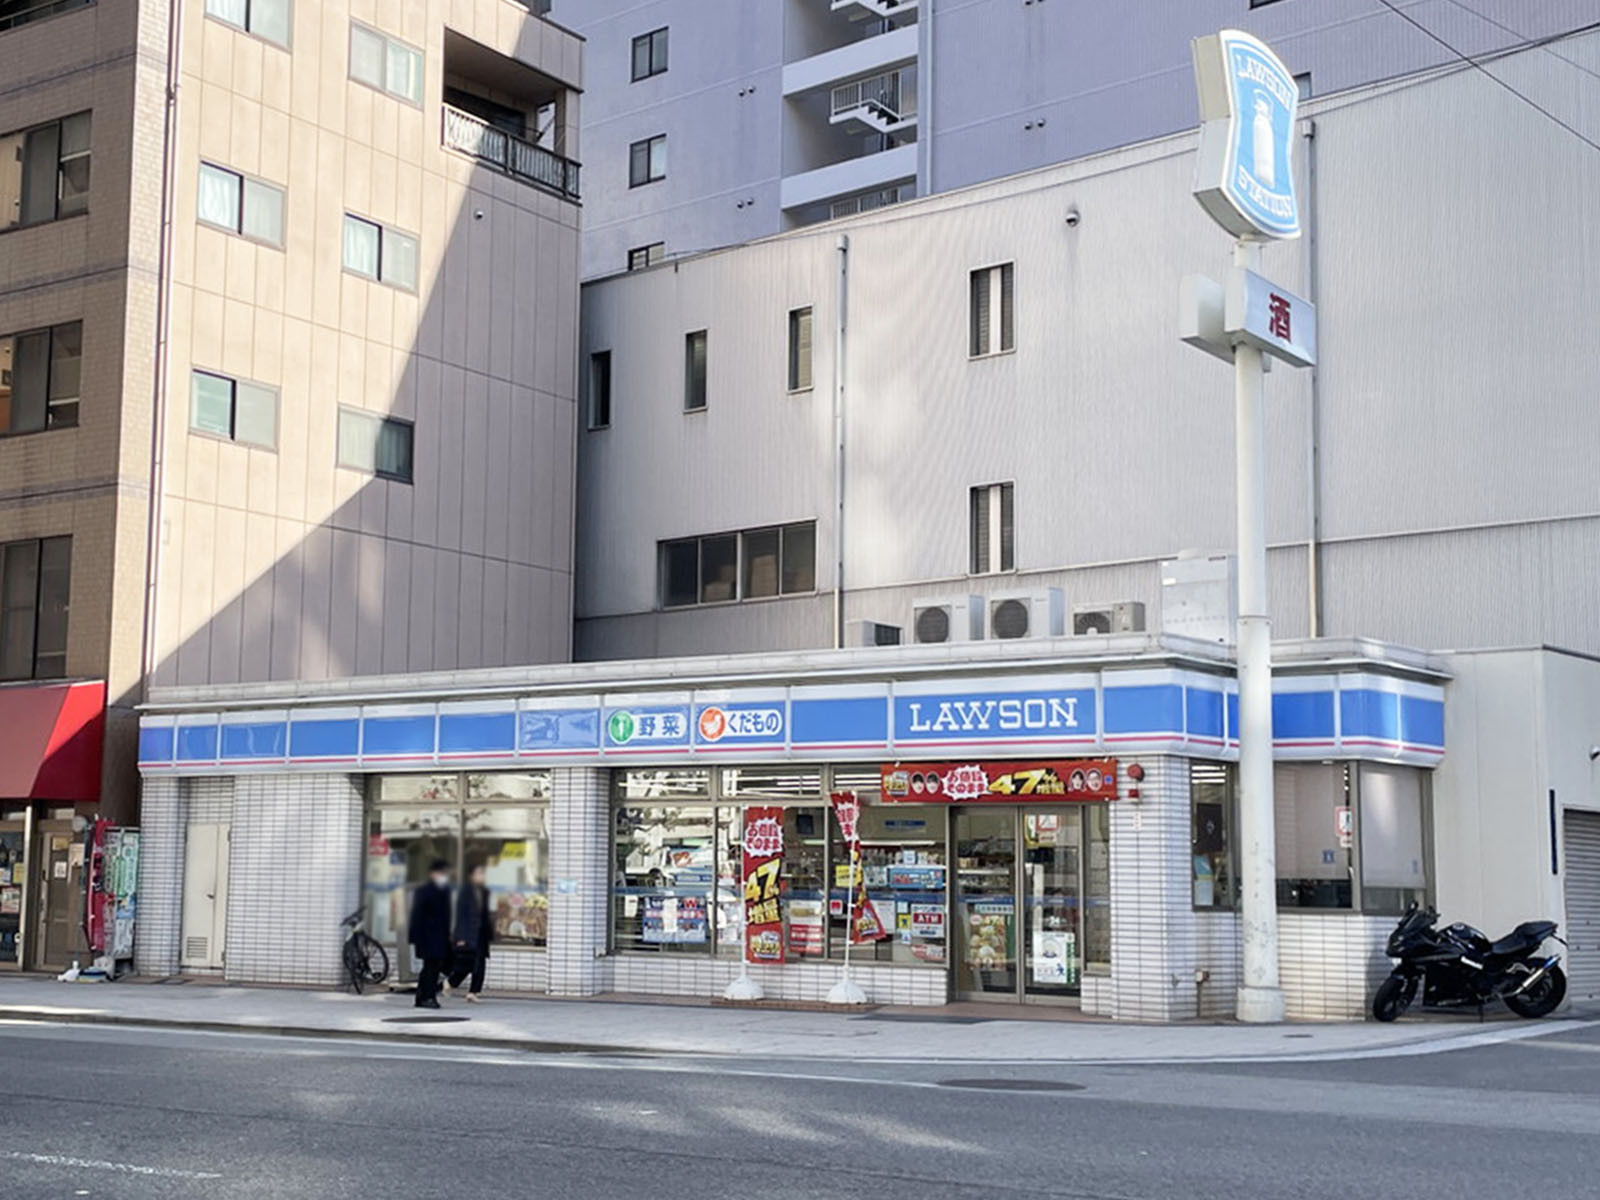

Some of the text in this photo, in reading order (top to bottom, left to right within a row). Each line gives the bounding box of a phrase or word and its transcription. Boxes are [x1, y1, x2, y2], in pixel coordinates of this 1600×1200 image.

[1236, 53, 1293, 111] LAWSON
[1236, 165, 1293, 218] STATION
[1268, 292, 1292, 343] 酒
[638, 714, 680, 737] 野菜
[726, 712, 780, 734] くだもの
[909, 697, 1078, 732] LAWSON
[917, 914, 939, 923] ATM
